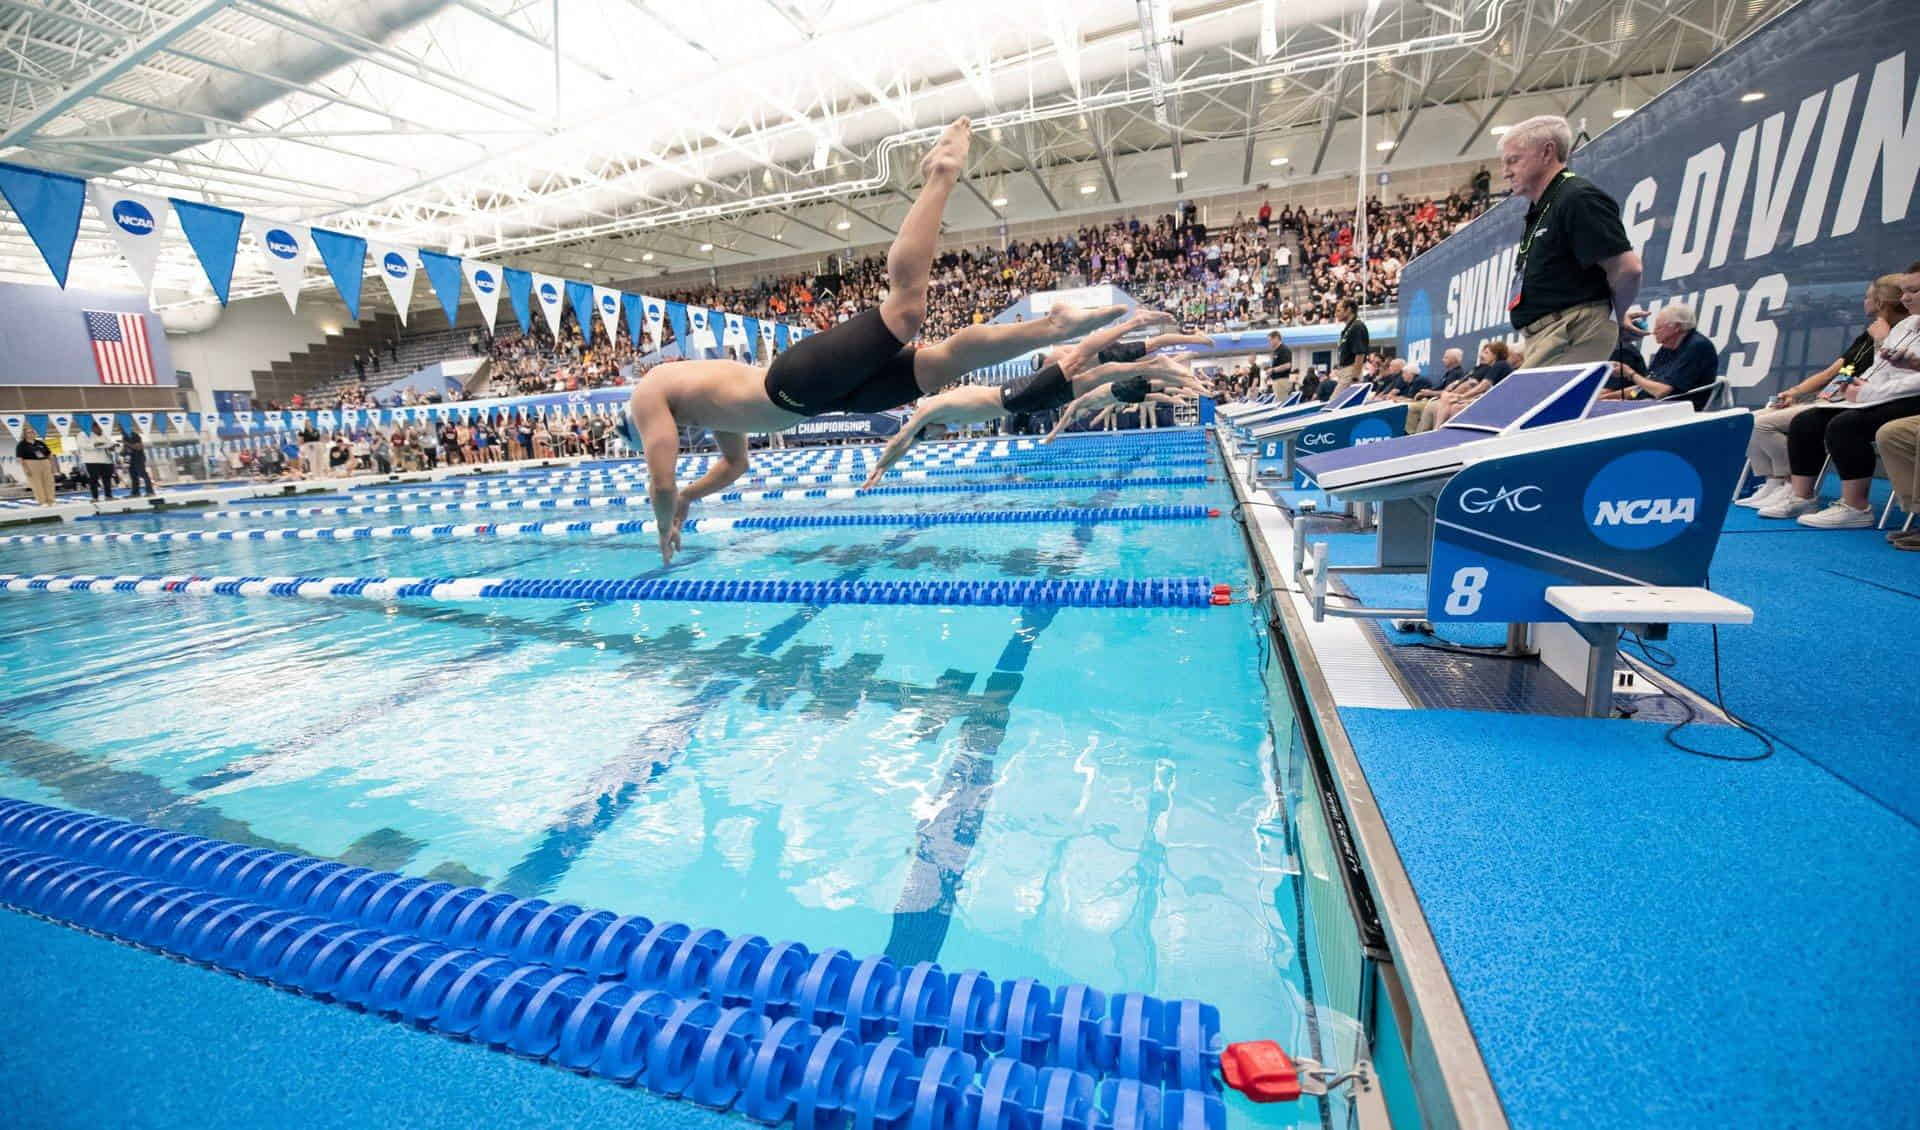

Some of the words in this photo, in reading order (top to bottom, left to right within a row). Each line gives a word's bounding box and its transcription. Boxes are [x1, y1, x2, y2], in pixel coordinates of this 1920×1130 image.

[118, 214, 154, 229] NCAA
[798, 420, 871, 434] CHAMPIONSHIPS
[1303, 433, 1336, 446] GAC
[1266, 442, 1277, 457] 6
[1459, 485, 1543, 514] GAC
[1593, 498, 1696, 526] NCAA
[1444, 567, 1489, 616] 8
